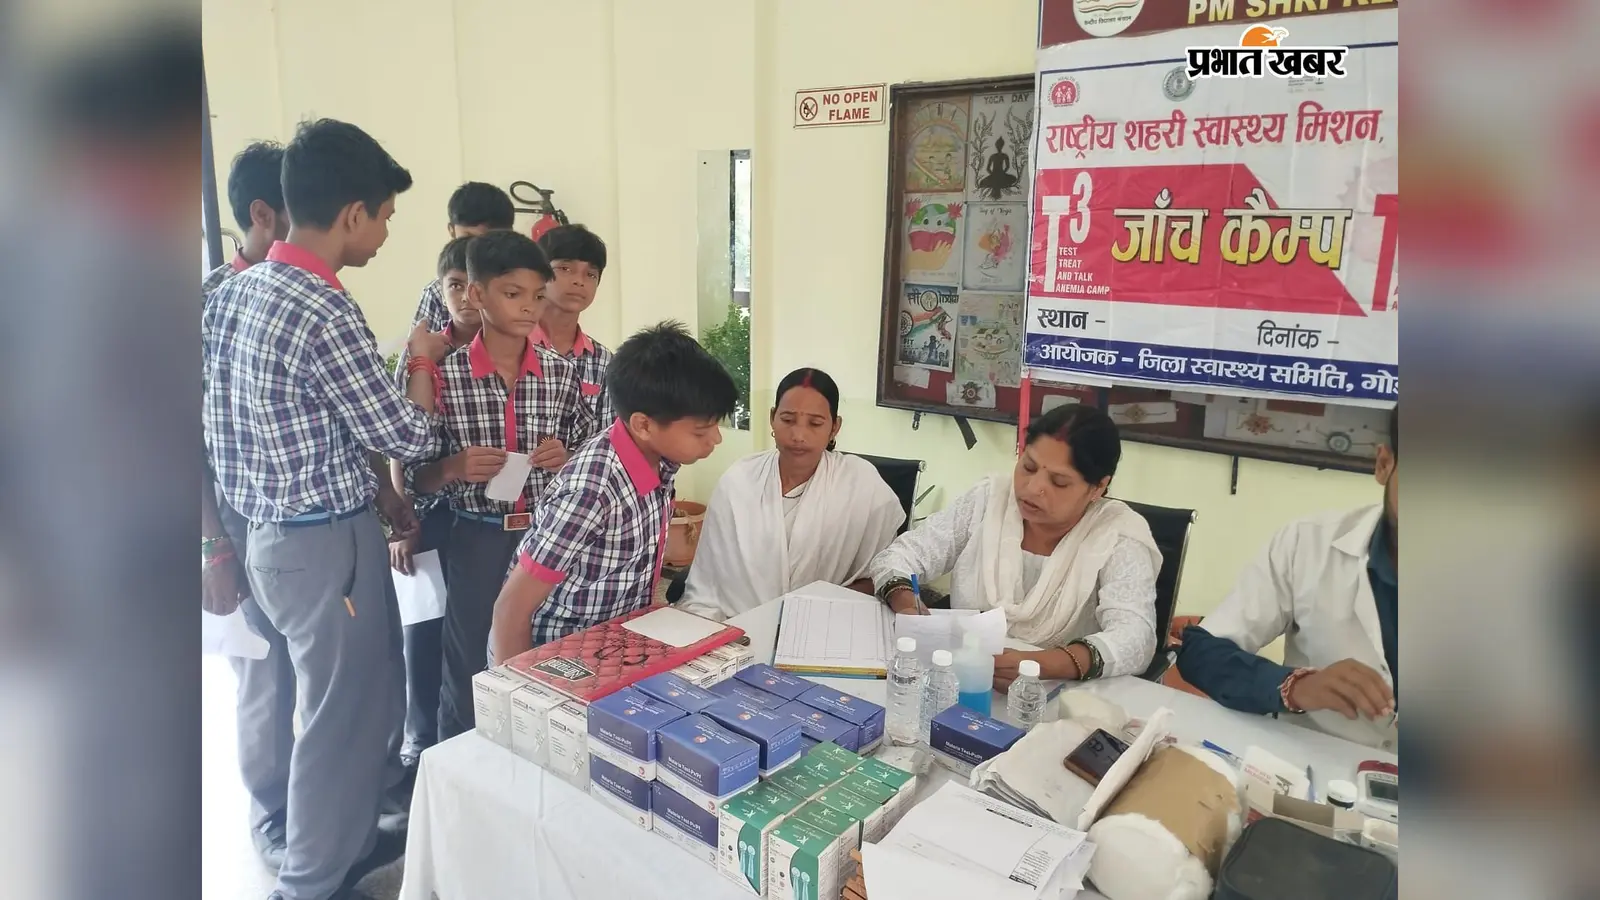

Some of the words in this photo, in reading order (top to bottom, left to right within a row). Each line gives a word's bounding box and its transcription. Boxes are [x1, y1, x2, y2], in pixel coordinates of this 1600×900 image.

[1187, 0, 1234, 24] PM
[822, 94, 840, 105] NO
[844, 90, 878, 104] OPEN
[1011, 92, 1030, 103] DAY
[829, 107, 870, 121] FLAME
[1046, 114, 1118, 159] राष्ट्रीय
[1124, 109, 1188, 150] शहरी
[1193, 112, 1289, 149] स्वास्थ्य
[1295, 100, 1385, 145] मिशन,
[1219, 187, 1353, 270] कैम्प
[1059, 246, 1078, 256] TEST
[1058, 259, 1082, 268] TREAT
[1057, 271, 1072, 281] AND
[1074, 272, 1093, 282] TALK
[1055, 283, 1085, 294] ANEMIA
[1086, 285, 1110, 295] CAMP
[1037, 308, 1089, 330] स्थान
[1257, 319, 1322, 350] दिनांक
[1039, 341, 1120, 366] आयोजक
[1138, 347, 1188, 374] जिला
[1190, 357, 1268, 382] स्वास्थ्य
[1269, 361, 1355, 392] समिति,
